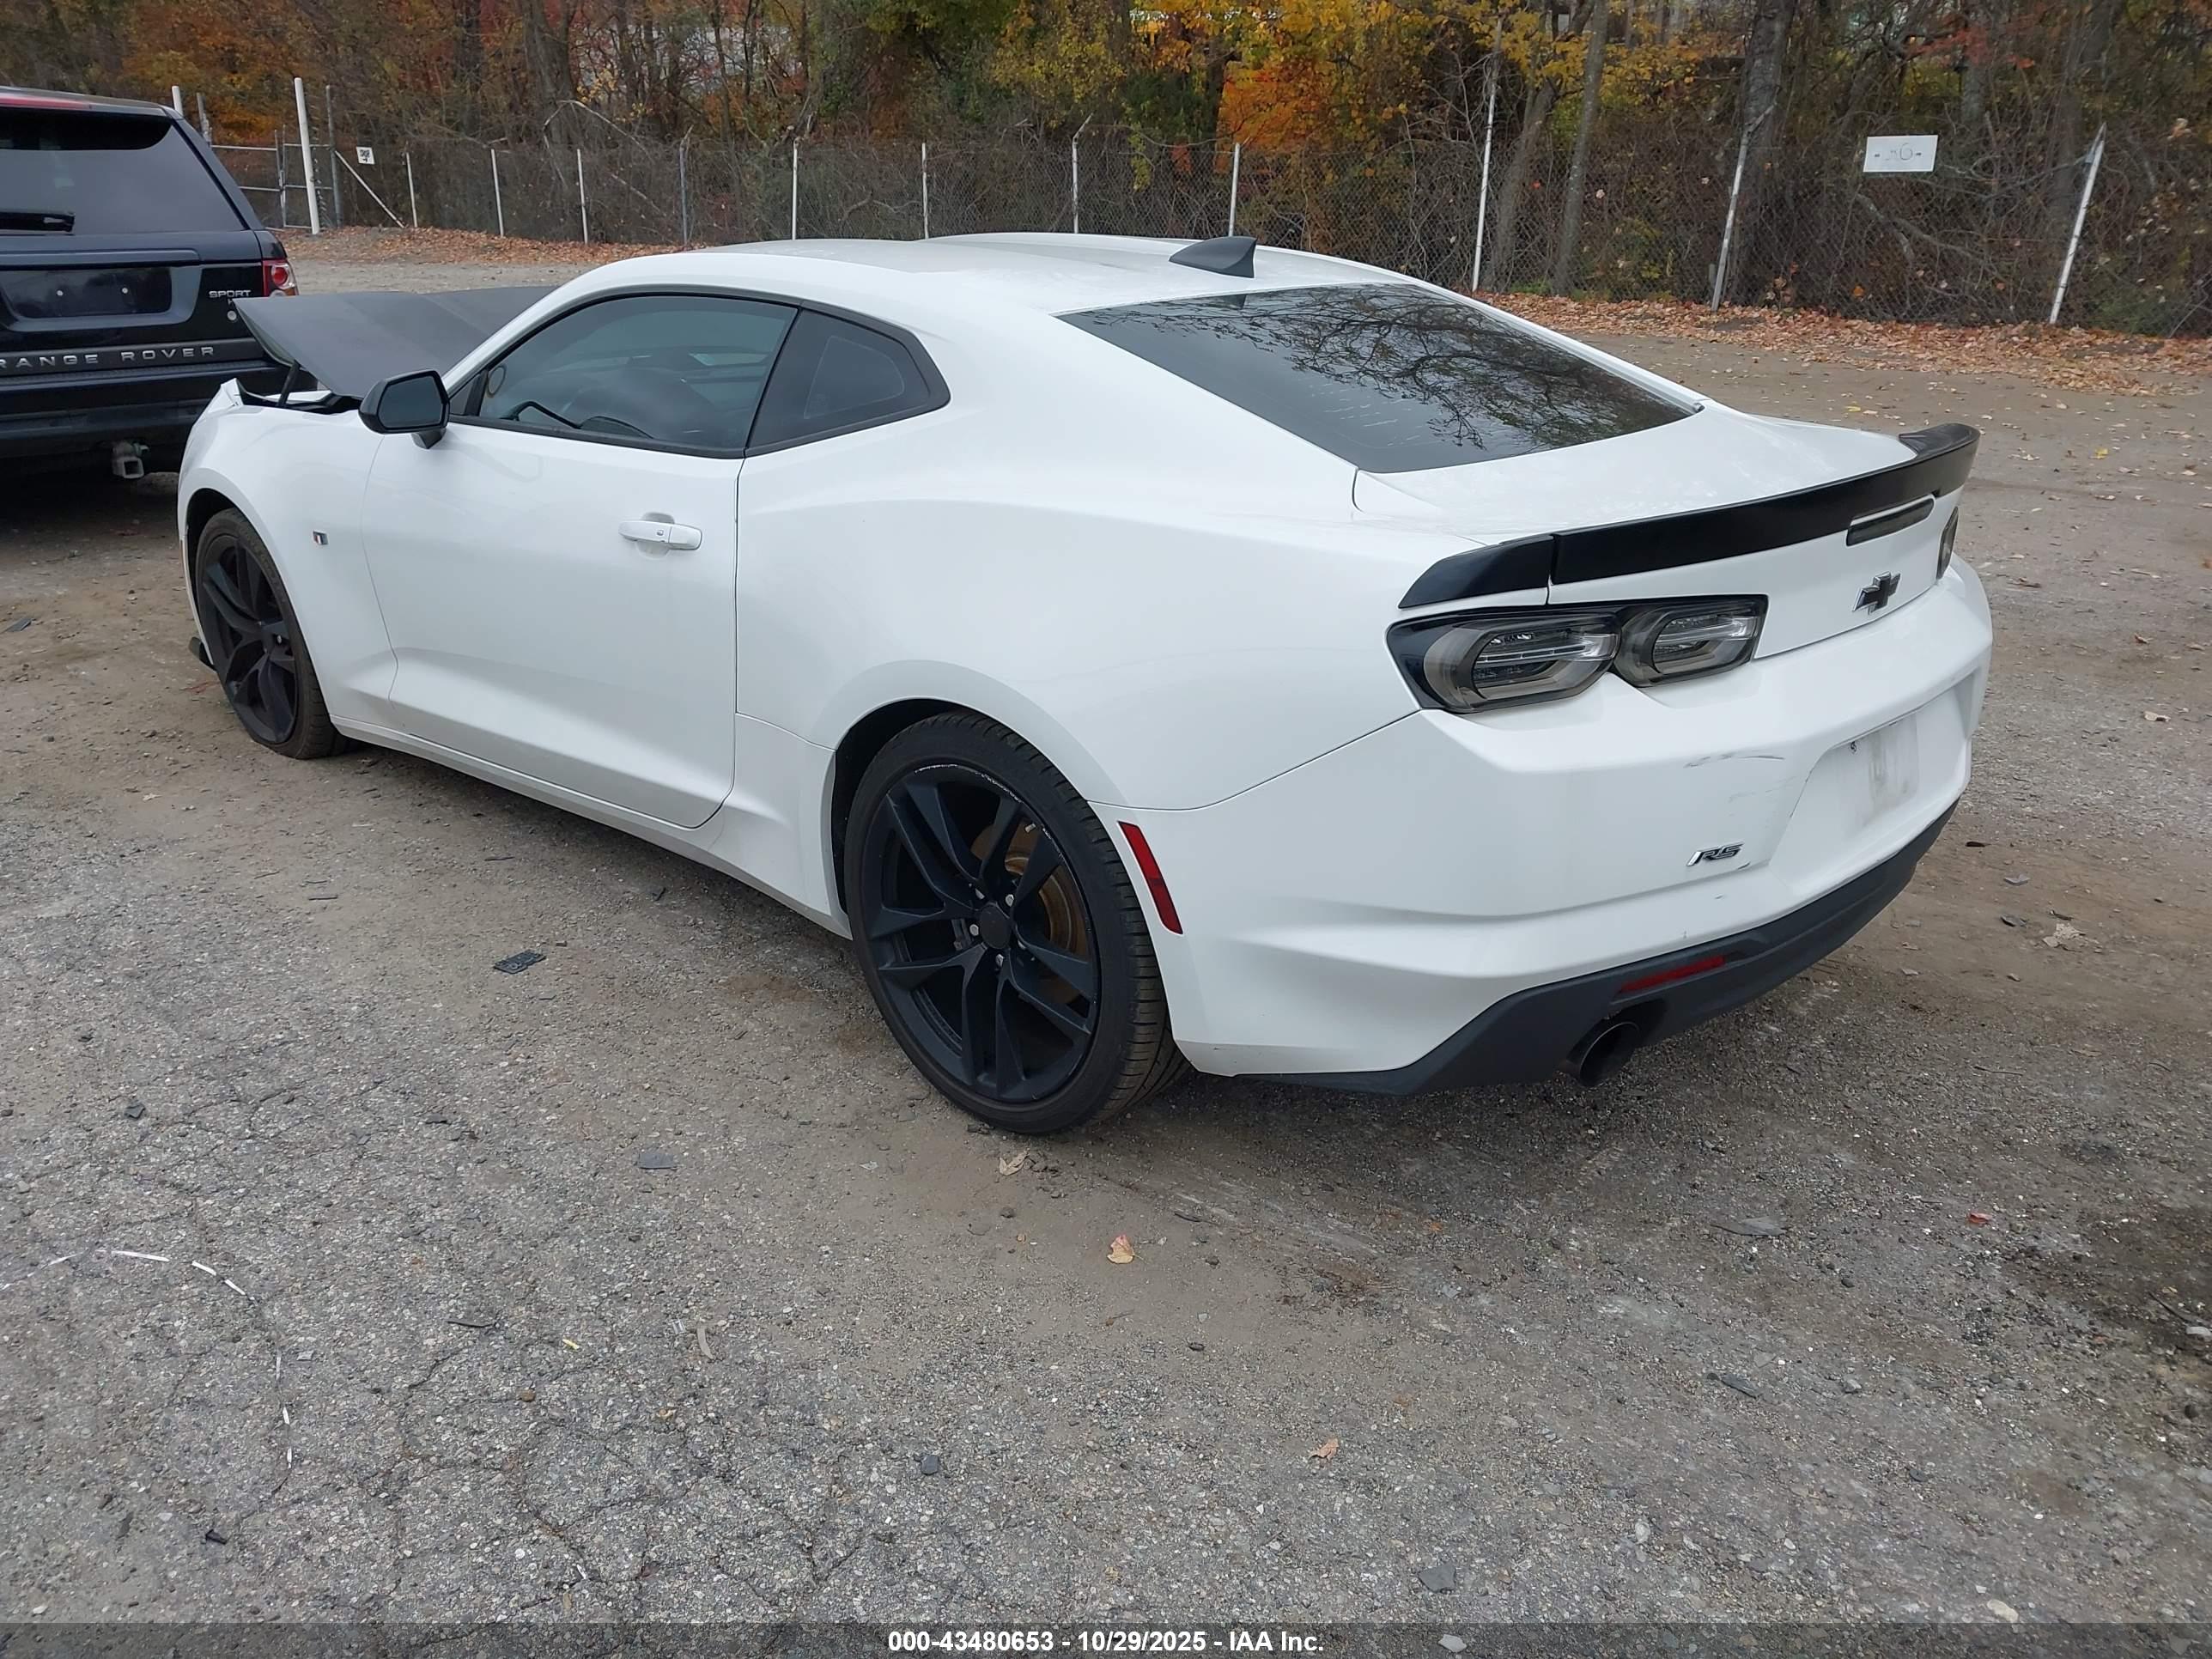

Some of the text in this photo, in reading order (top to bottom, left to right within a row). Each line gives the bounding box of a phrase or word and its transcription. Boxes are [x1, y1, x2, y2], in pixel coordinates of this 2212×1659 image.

[209, 289, 252, 298] SPORT
[120, 346, 214, 362] ROVER
[1686, 842, 1745, 866] RS
